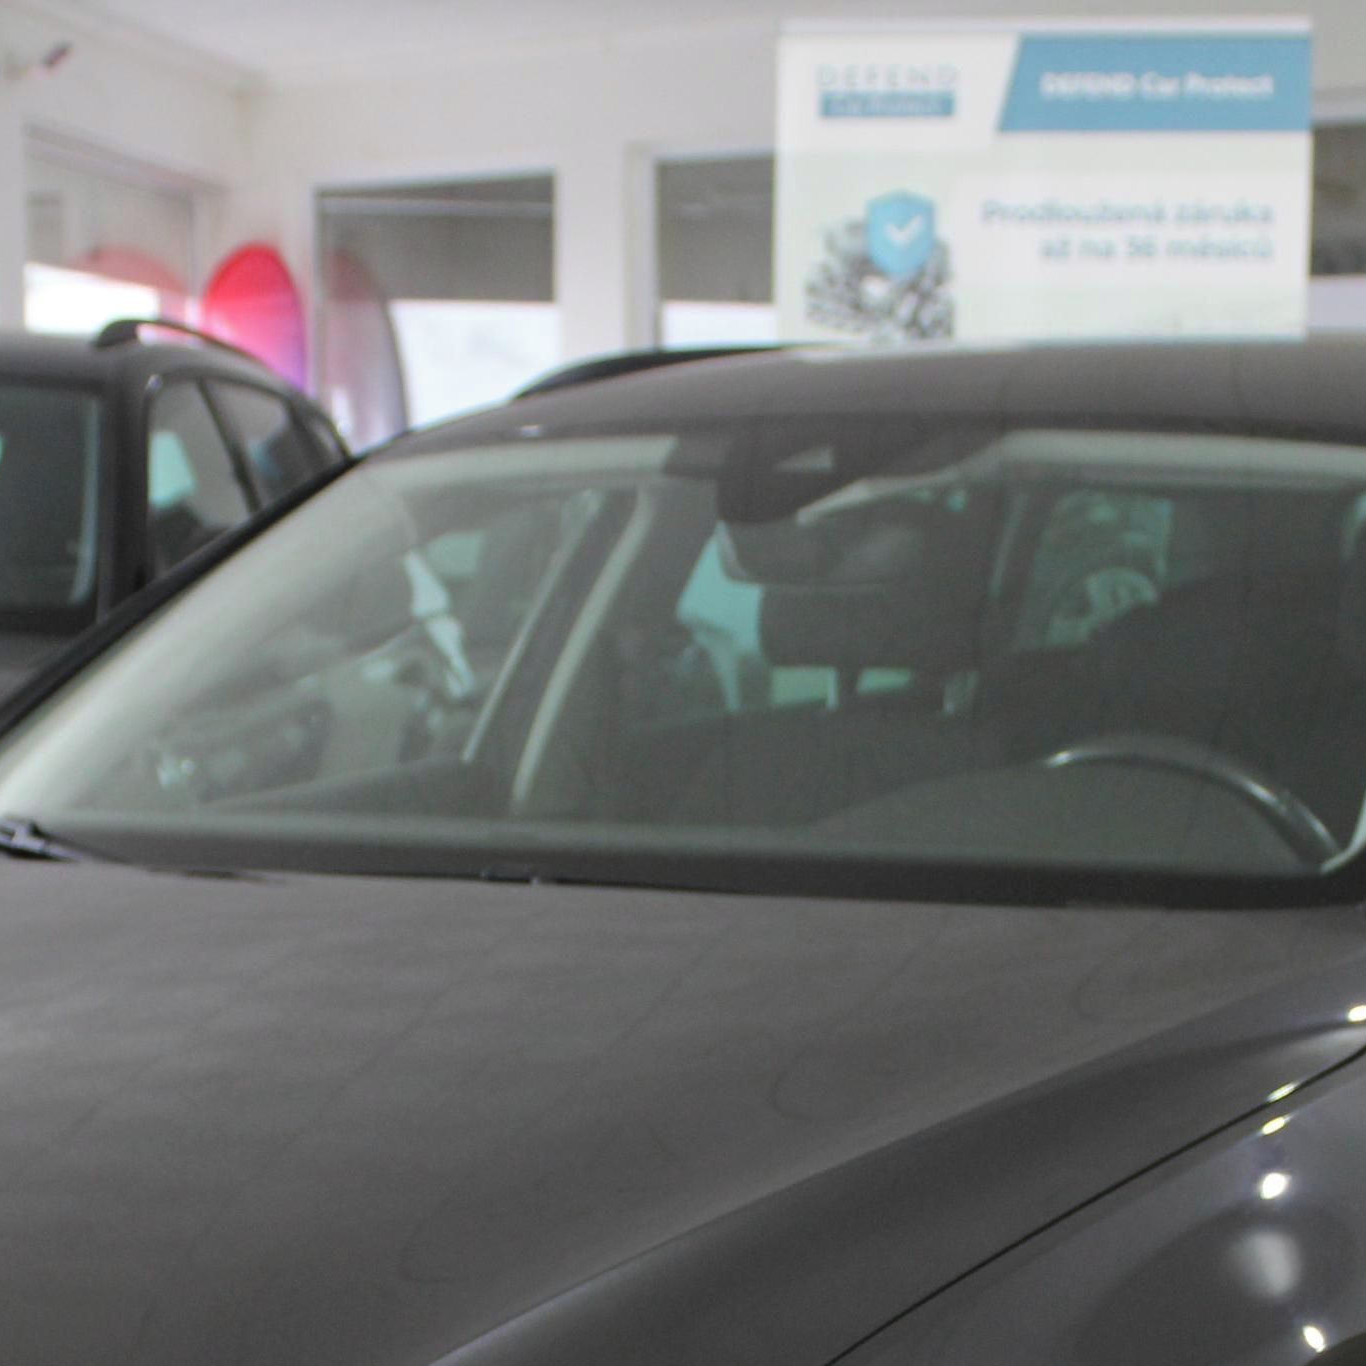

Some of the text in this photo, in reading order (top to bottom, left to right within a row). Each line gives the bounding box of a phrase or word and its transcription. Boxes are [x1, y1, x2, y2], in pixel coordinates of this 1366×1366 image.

[817, 64, 958, 88] DEFEND
[1039, 71, 1273, 96] DEFEND Car Protect
[1079, 239, 1115, 257] na
